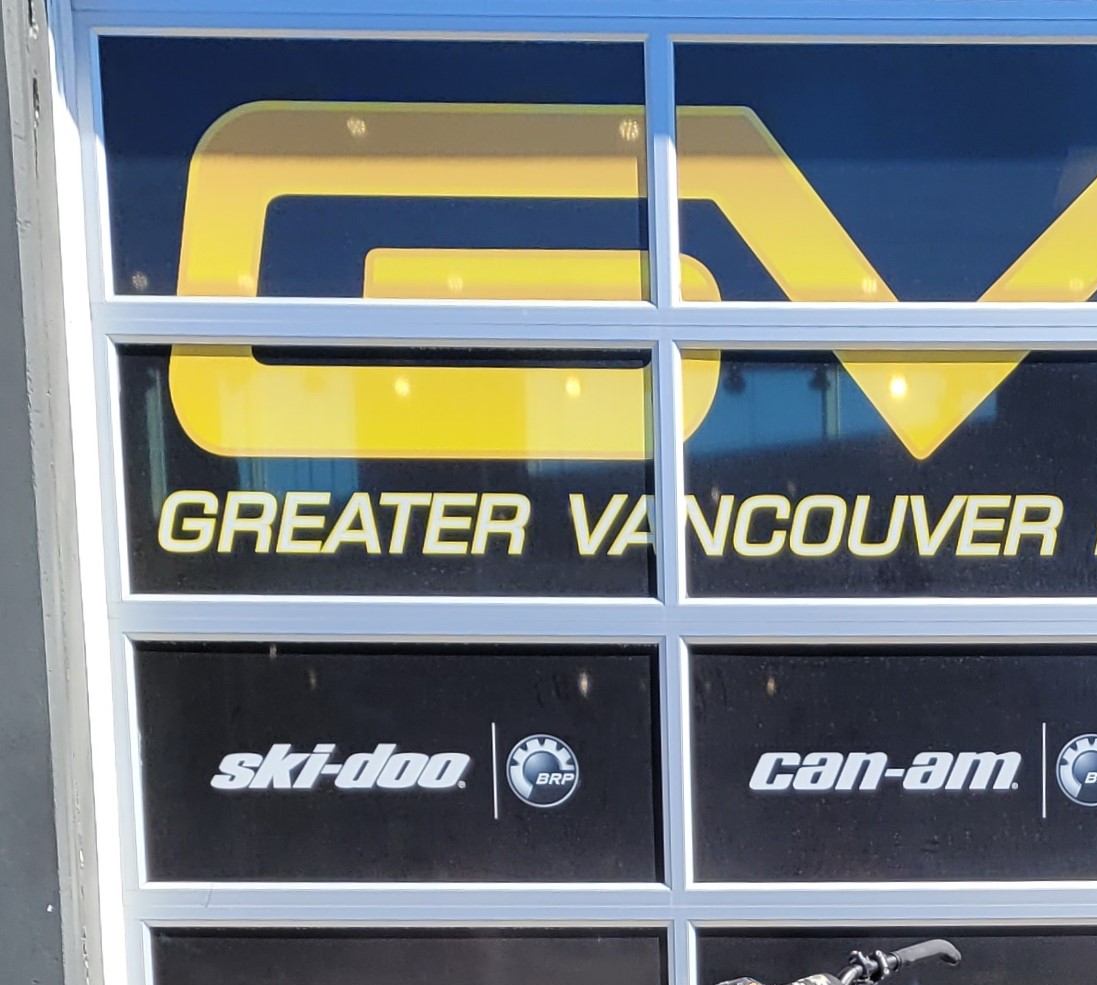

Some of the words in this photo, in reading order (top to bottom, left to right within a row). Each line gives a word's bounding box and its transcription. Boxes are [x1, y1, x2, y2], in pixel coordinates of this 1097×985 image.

[157, 490, 531, 555] GREATER
[568, 493, 1065, 557] VANCOUVER
[210, 743, 471, 789] ski-doo
[535, 772, 575, 786] BRP
[748, 751, 1022, 790] can-am
